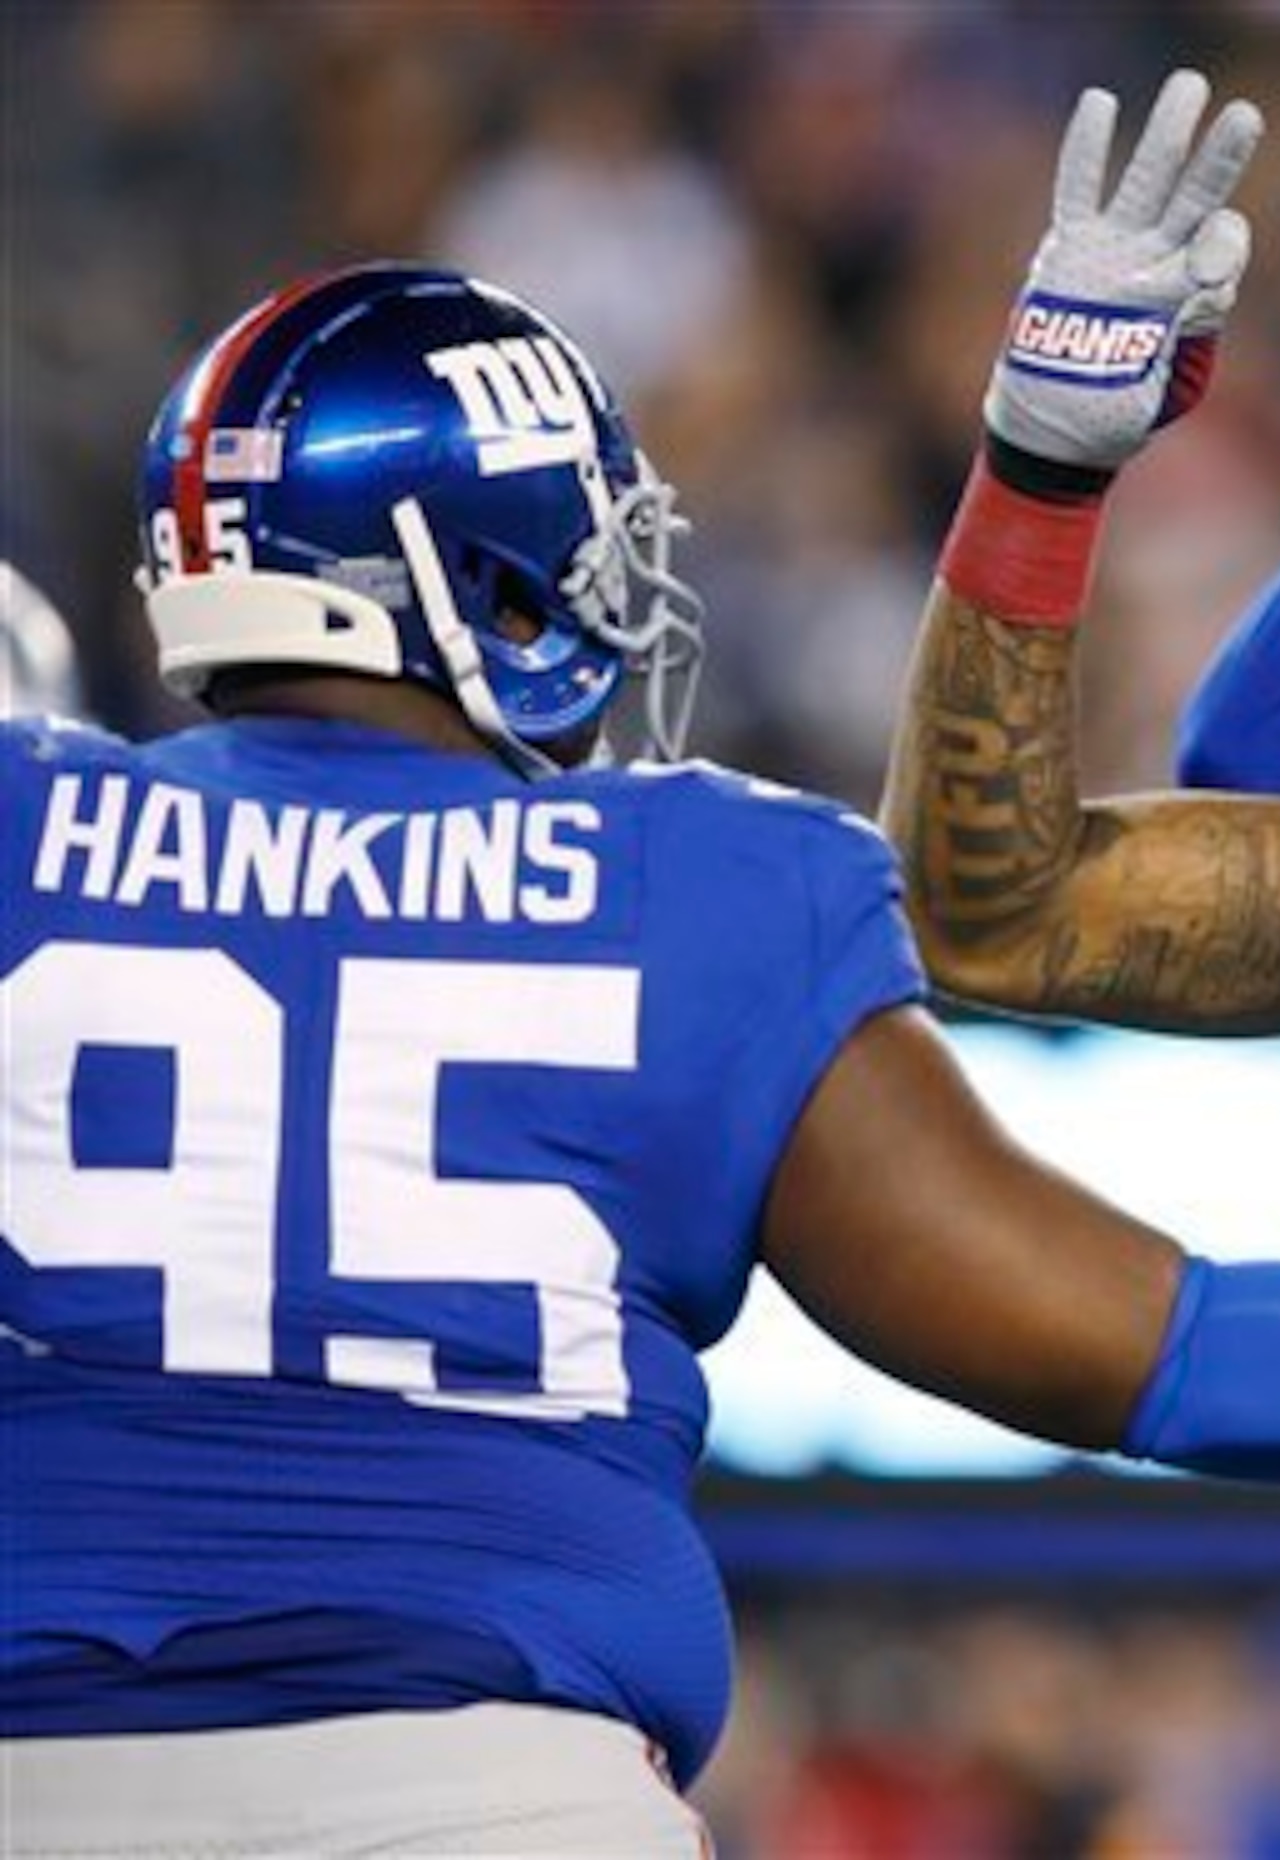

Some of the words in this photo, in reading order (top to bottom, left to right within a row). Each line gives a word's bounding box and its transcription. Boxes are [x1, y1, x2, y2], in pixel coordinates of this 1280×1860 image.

[1014, 304, 1168, 362] GIANTS
[152, 497, 251, 590] 95
[32, 773, 601, 924] HANKINS
[0, 940, 641, 1422] 95
